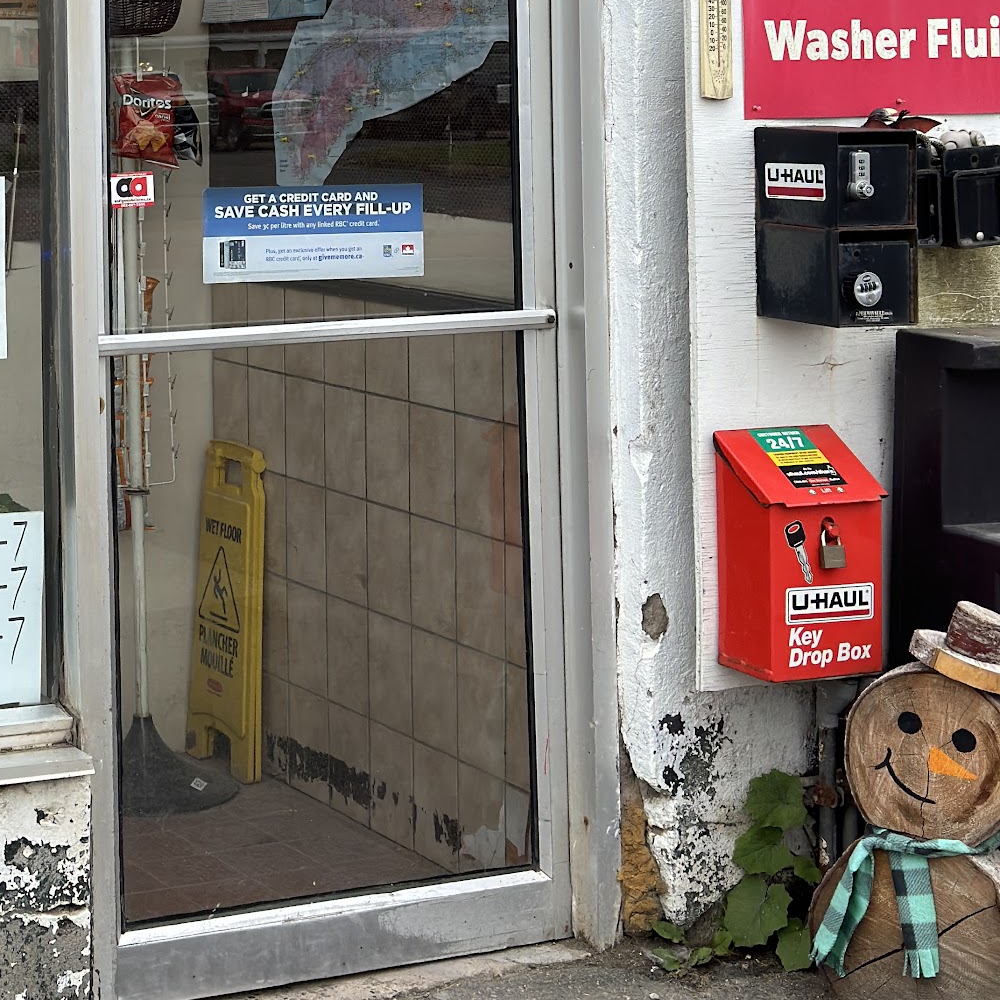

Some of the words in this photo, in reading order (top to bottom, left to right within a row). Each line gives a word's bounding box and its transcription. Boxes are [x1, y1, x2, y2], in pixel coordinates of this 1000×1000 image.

[763, 19, 916, 60] Washer
[927, 15, 1000, 58] Flui
[122, 94, 171, 110] Doritos
[767, 168, 824, 184] U-HAUL
[244, 194, 266, 203] GET
[268, 194, 277, 203] A
[279, 192, 319, 203] CREDIT
[321, 192, 352, 202] CARD
[354, 191, 379, 201] AND
[214, 205, 255, 219] SAVE
[258, 204, 300, 217] CASH
[303, 203, 352, 216] EVERY
[356, 202, 412, 215] FILL-UP
[247, 222, 262, 230] Save
[293, 221, 305, 229] with
[766, 436, 804, 450] 24/7
[205, 517, 219, 537] WET
[219, 522, 242, 544] FLOOR
[792, 590, 869, 611] U-HAUL
[199, 624, 239, 658] PLANCHER
[789, 626, 823, 649] Key
[200, 647, 234, 679] MOUILLÉ
[789, 647, 834, 668] Drop
[837, 642, 872, 662] Box
